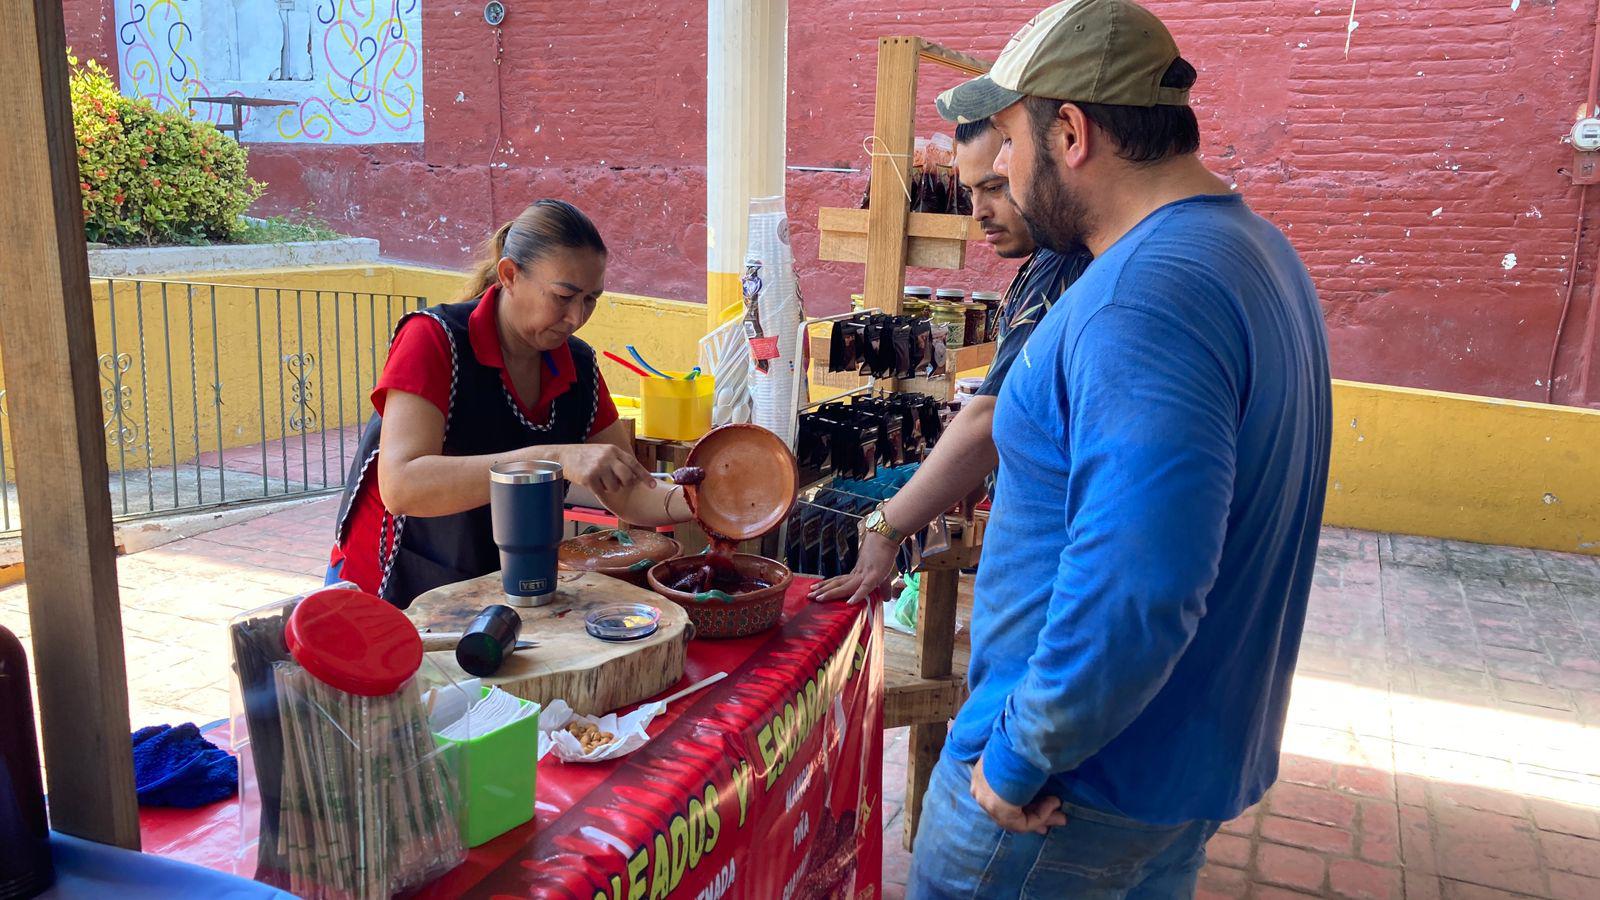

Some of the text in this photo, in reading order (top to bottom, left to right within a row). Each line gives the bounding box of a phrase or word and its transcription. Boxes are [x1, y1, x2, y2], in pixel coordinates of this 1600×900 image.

[521, 579, 545, 590] YETI
[731, 759, 749, 828] Y
[793, 810, 810, 853] PIÑA
